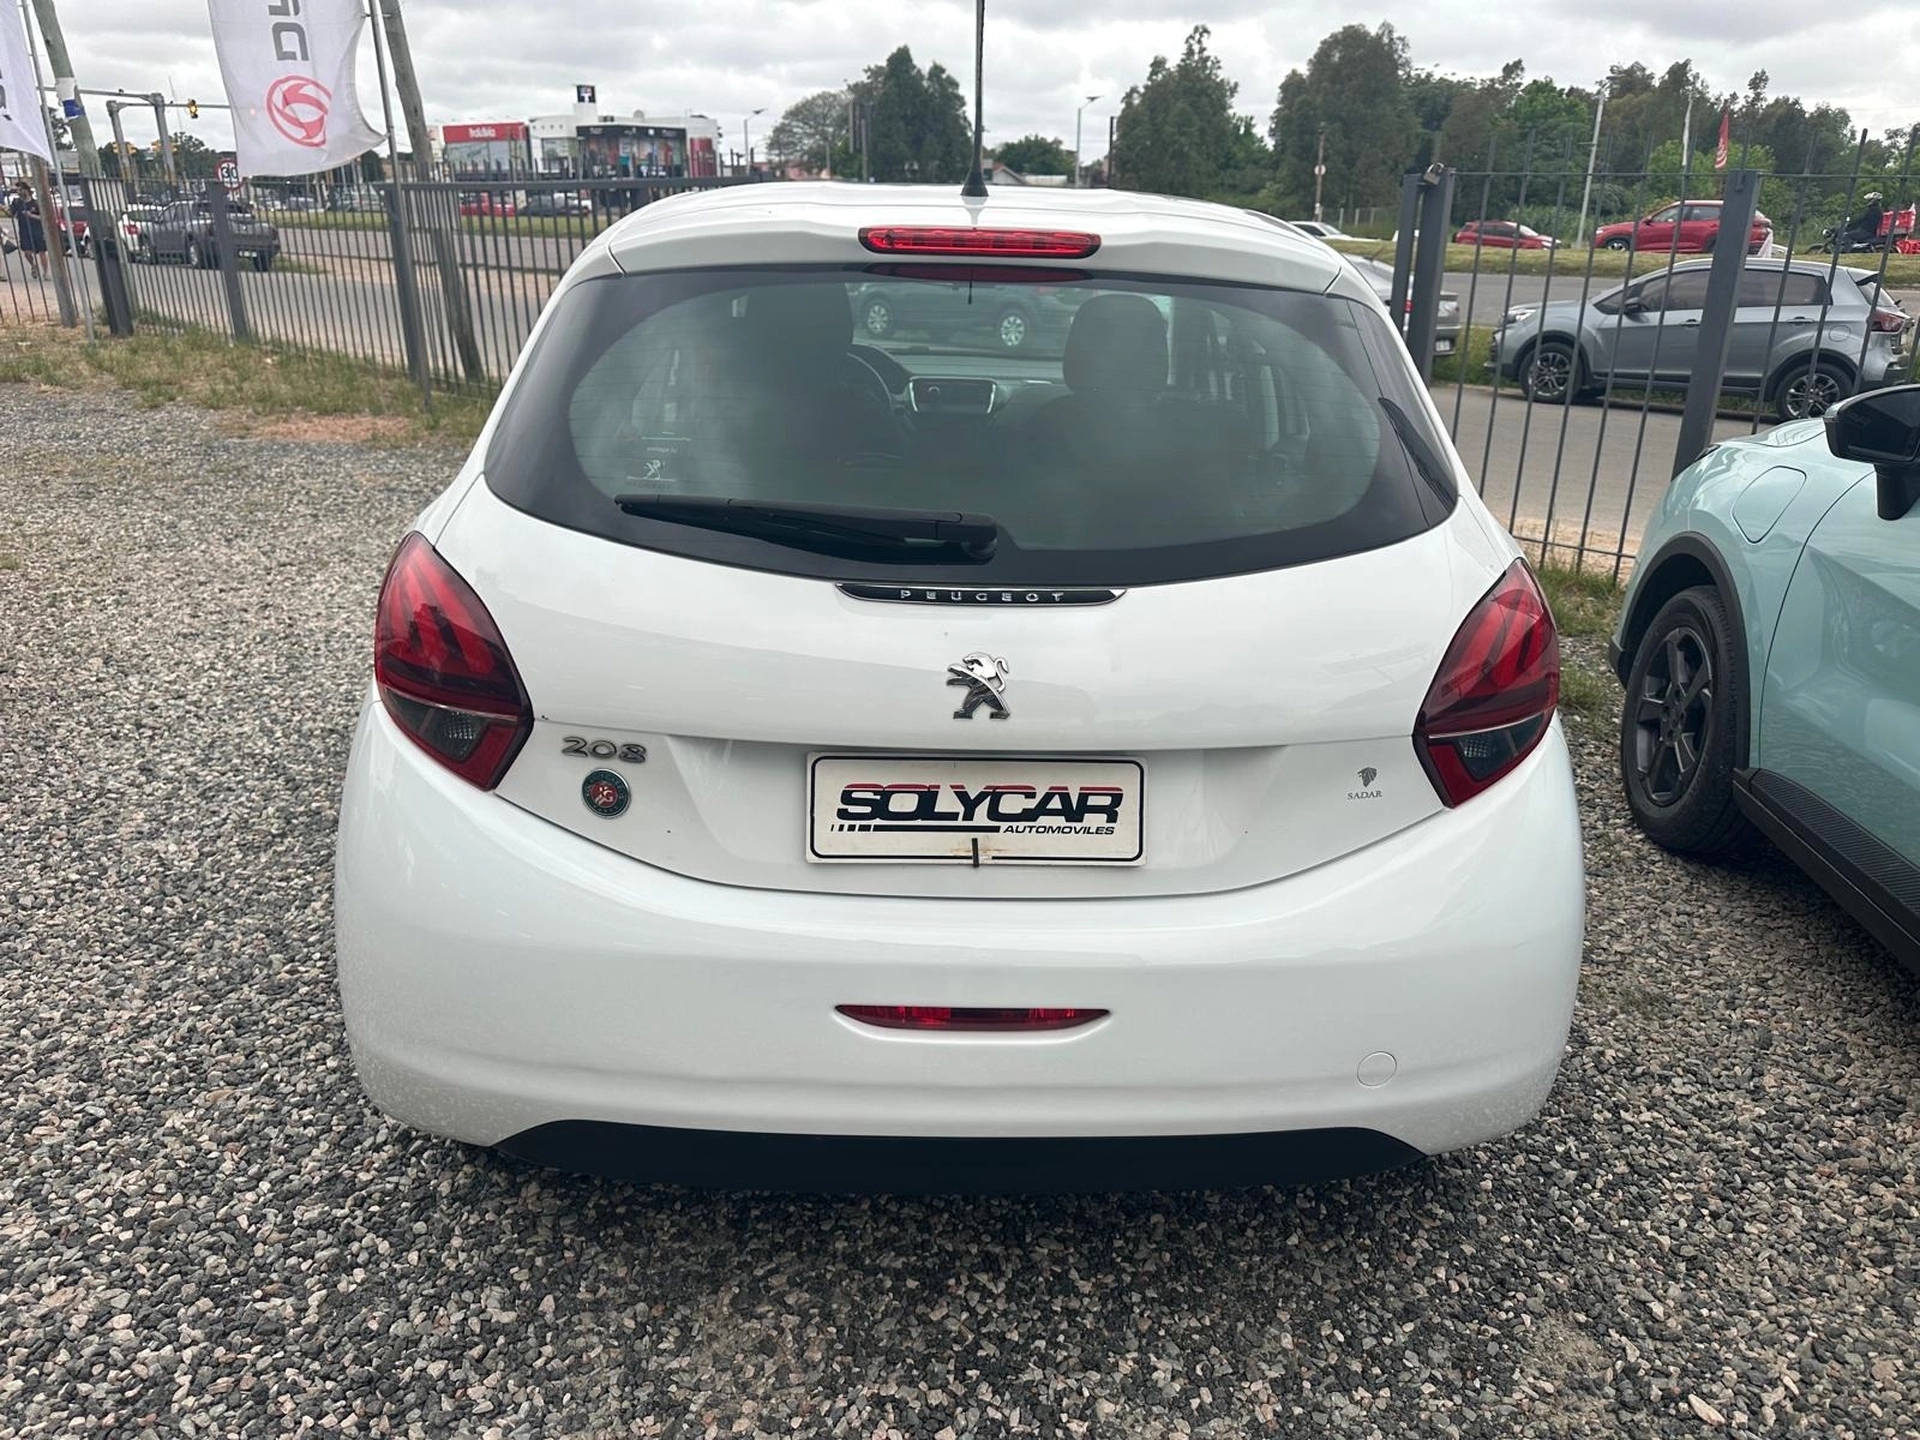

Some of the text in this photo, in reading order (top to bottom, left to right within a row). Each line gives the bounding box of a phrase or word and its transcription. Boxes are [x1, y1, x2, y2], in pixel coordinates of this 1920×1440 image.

[221, 166, 239, 179] 30
[900, 589, 1064, 602] PEUGEOT
[561, 736, 647, 764] 208
[1347, 790, 1383, 801] SADAR
[836, 783, 1124, 824] SOLYCAR
[1003, 825, 1116, 836] AUTOMOVILES
